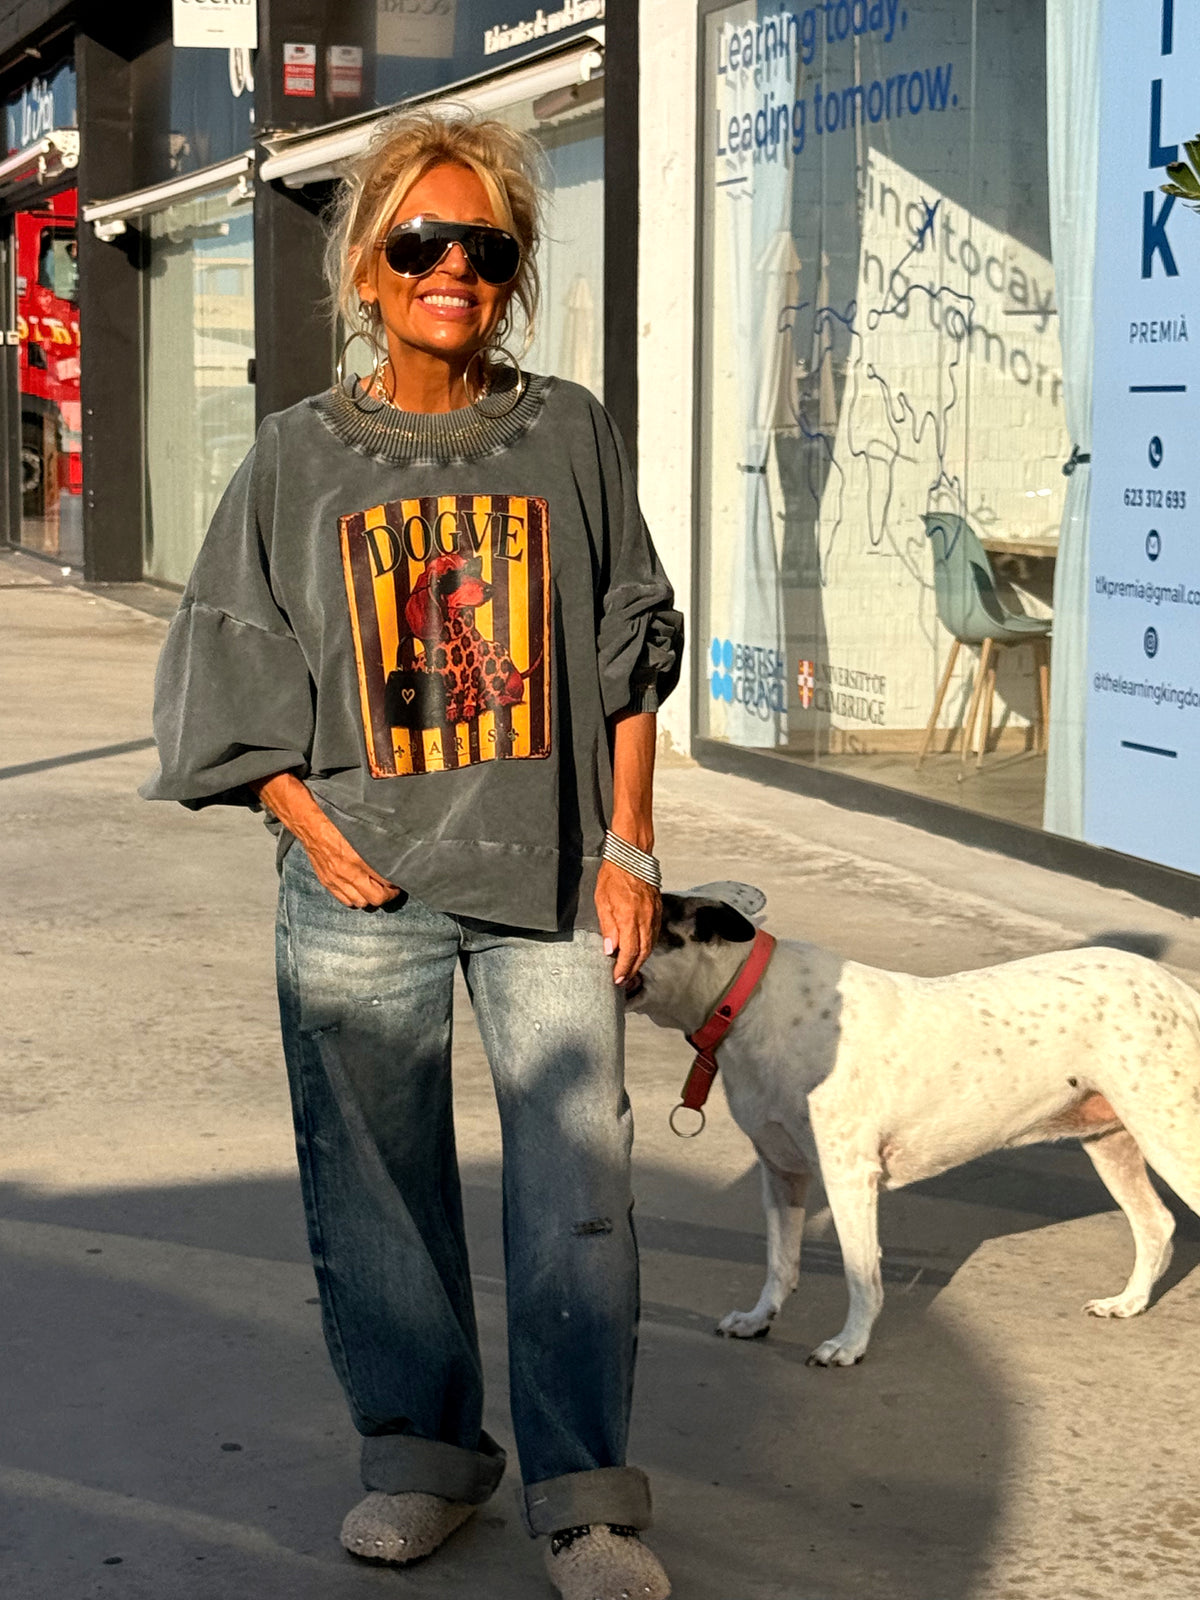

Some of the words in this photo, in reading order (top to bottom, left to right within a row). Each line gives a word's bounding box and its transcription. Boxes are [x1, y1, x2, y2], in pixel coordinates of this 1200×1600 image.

[717, 2, 817, 75] Learning
[716, 91, 806, 155] Leading
[814, 62, 959, 135] tomorrow.
[1128, 314, 1189, 344] PREMIÀ
[1123, 488, 1143, 507] 623
[1145, 489, 1163, 509] 312
[1166, 490, 1187, 510] 693
[361, 510, 526, 579] DOGVE
[1093, 671, 1200, 710] @thelearningkingdo
